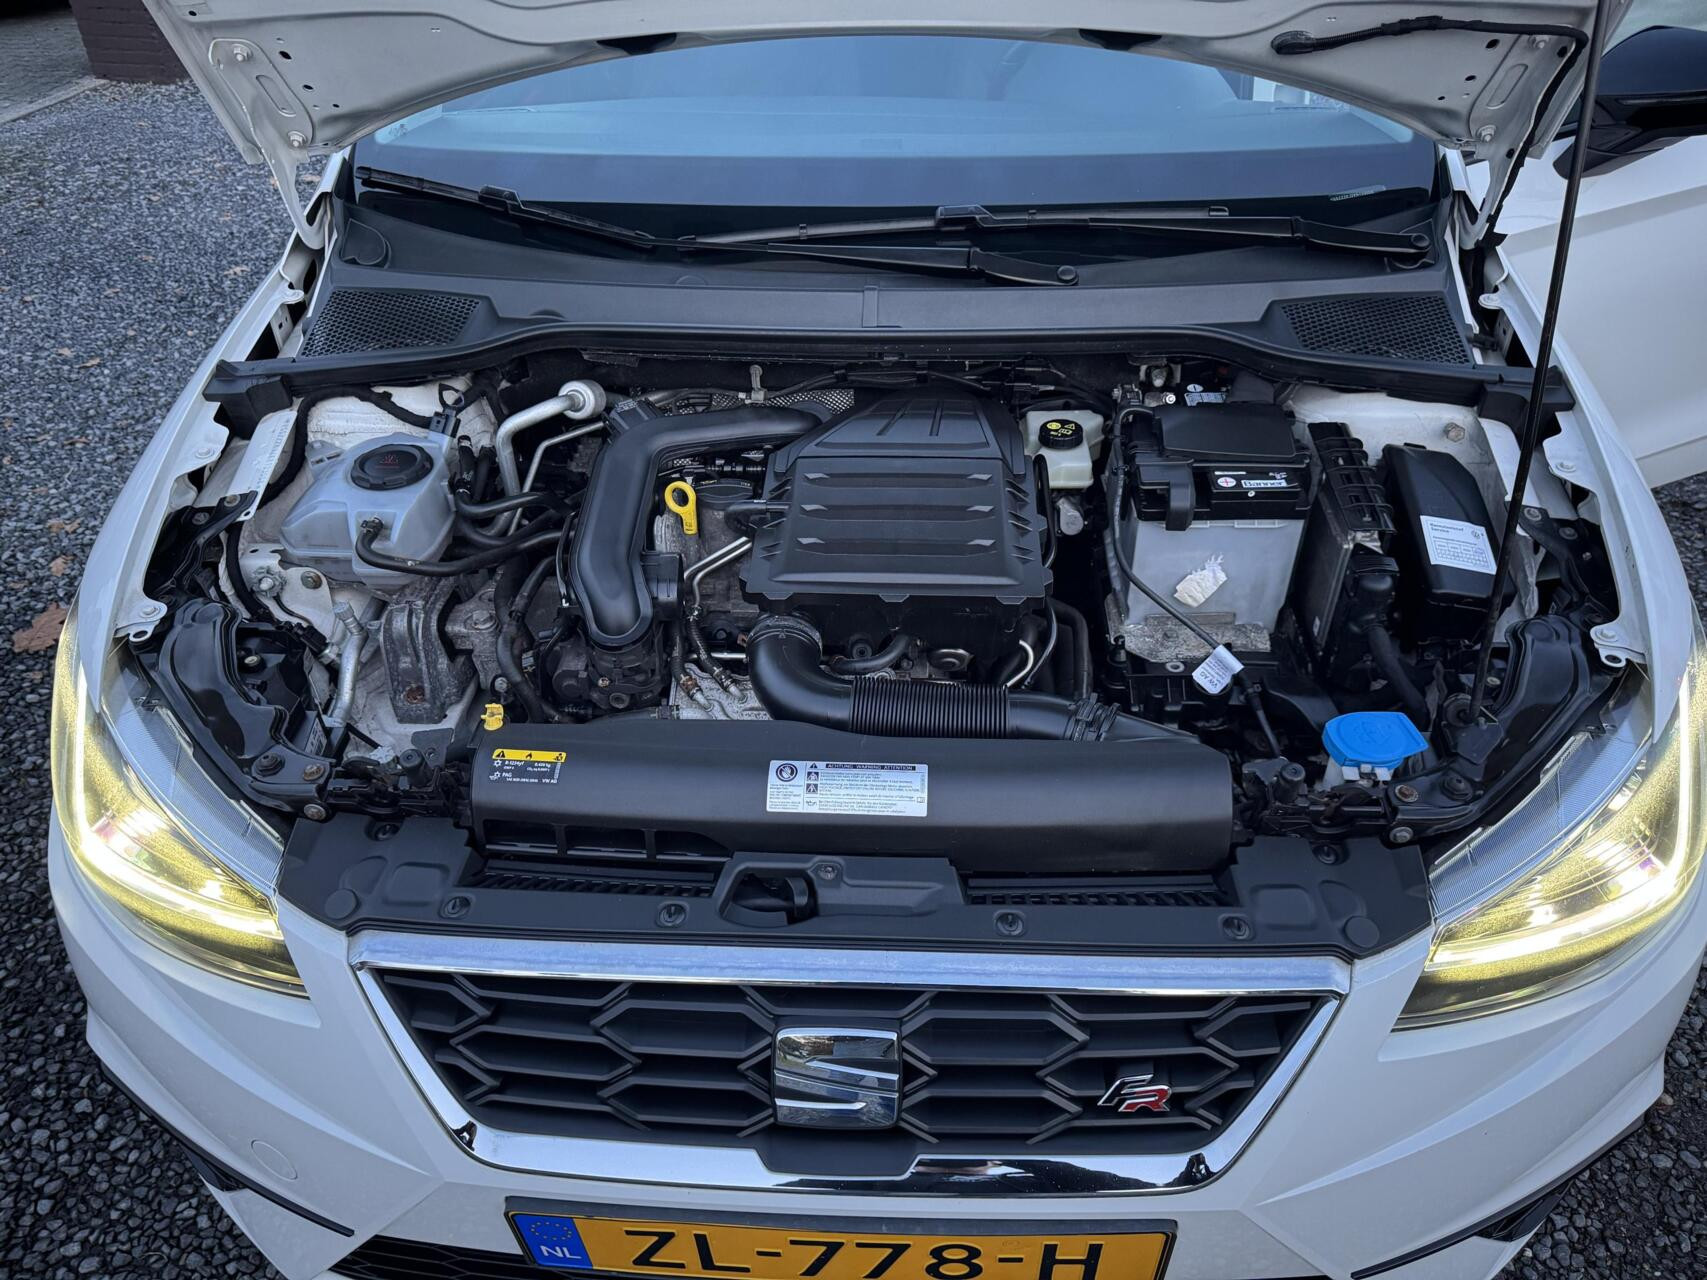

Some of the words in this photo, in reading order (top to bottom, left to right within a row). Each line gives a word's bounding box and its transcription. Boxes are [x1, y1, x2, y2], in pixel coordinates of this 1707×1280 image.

[1097, 1074, 1172, 1112] FR
[540, 1245, 582, 1260] NL
[623, 1229, 1104, 1280] ZL-778-H
